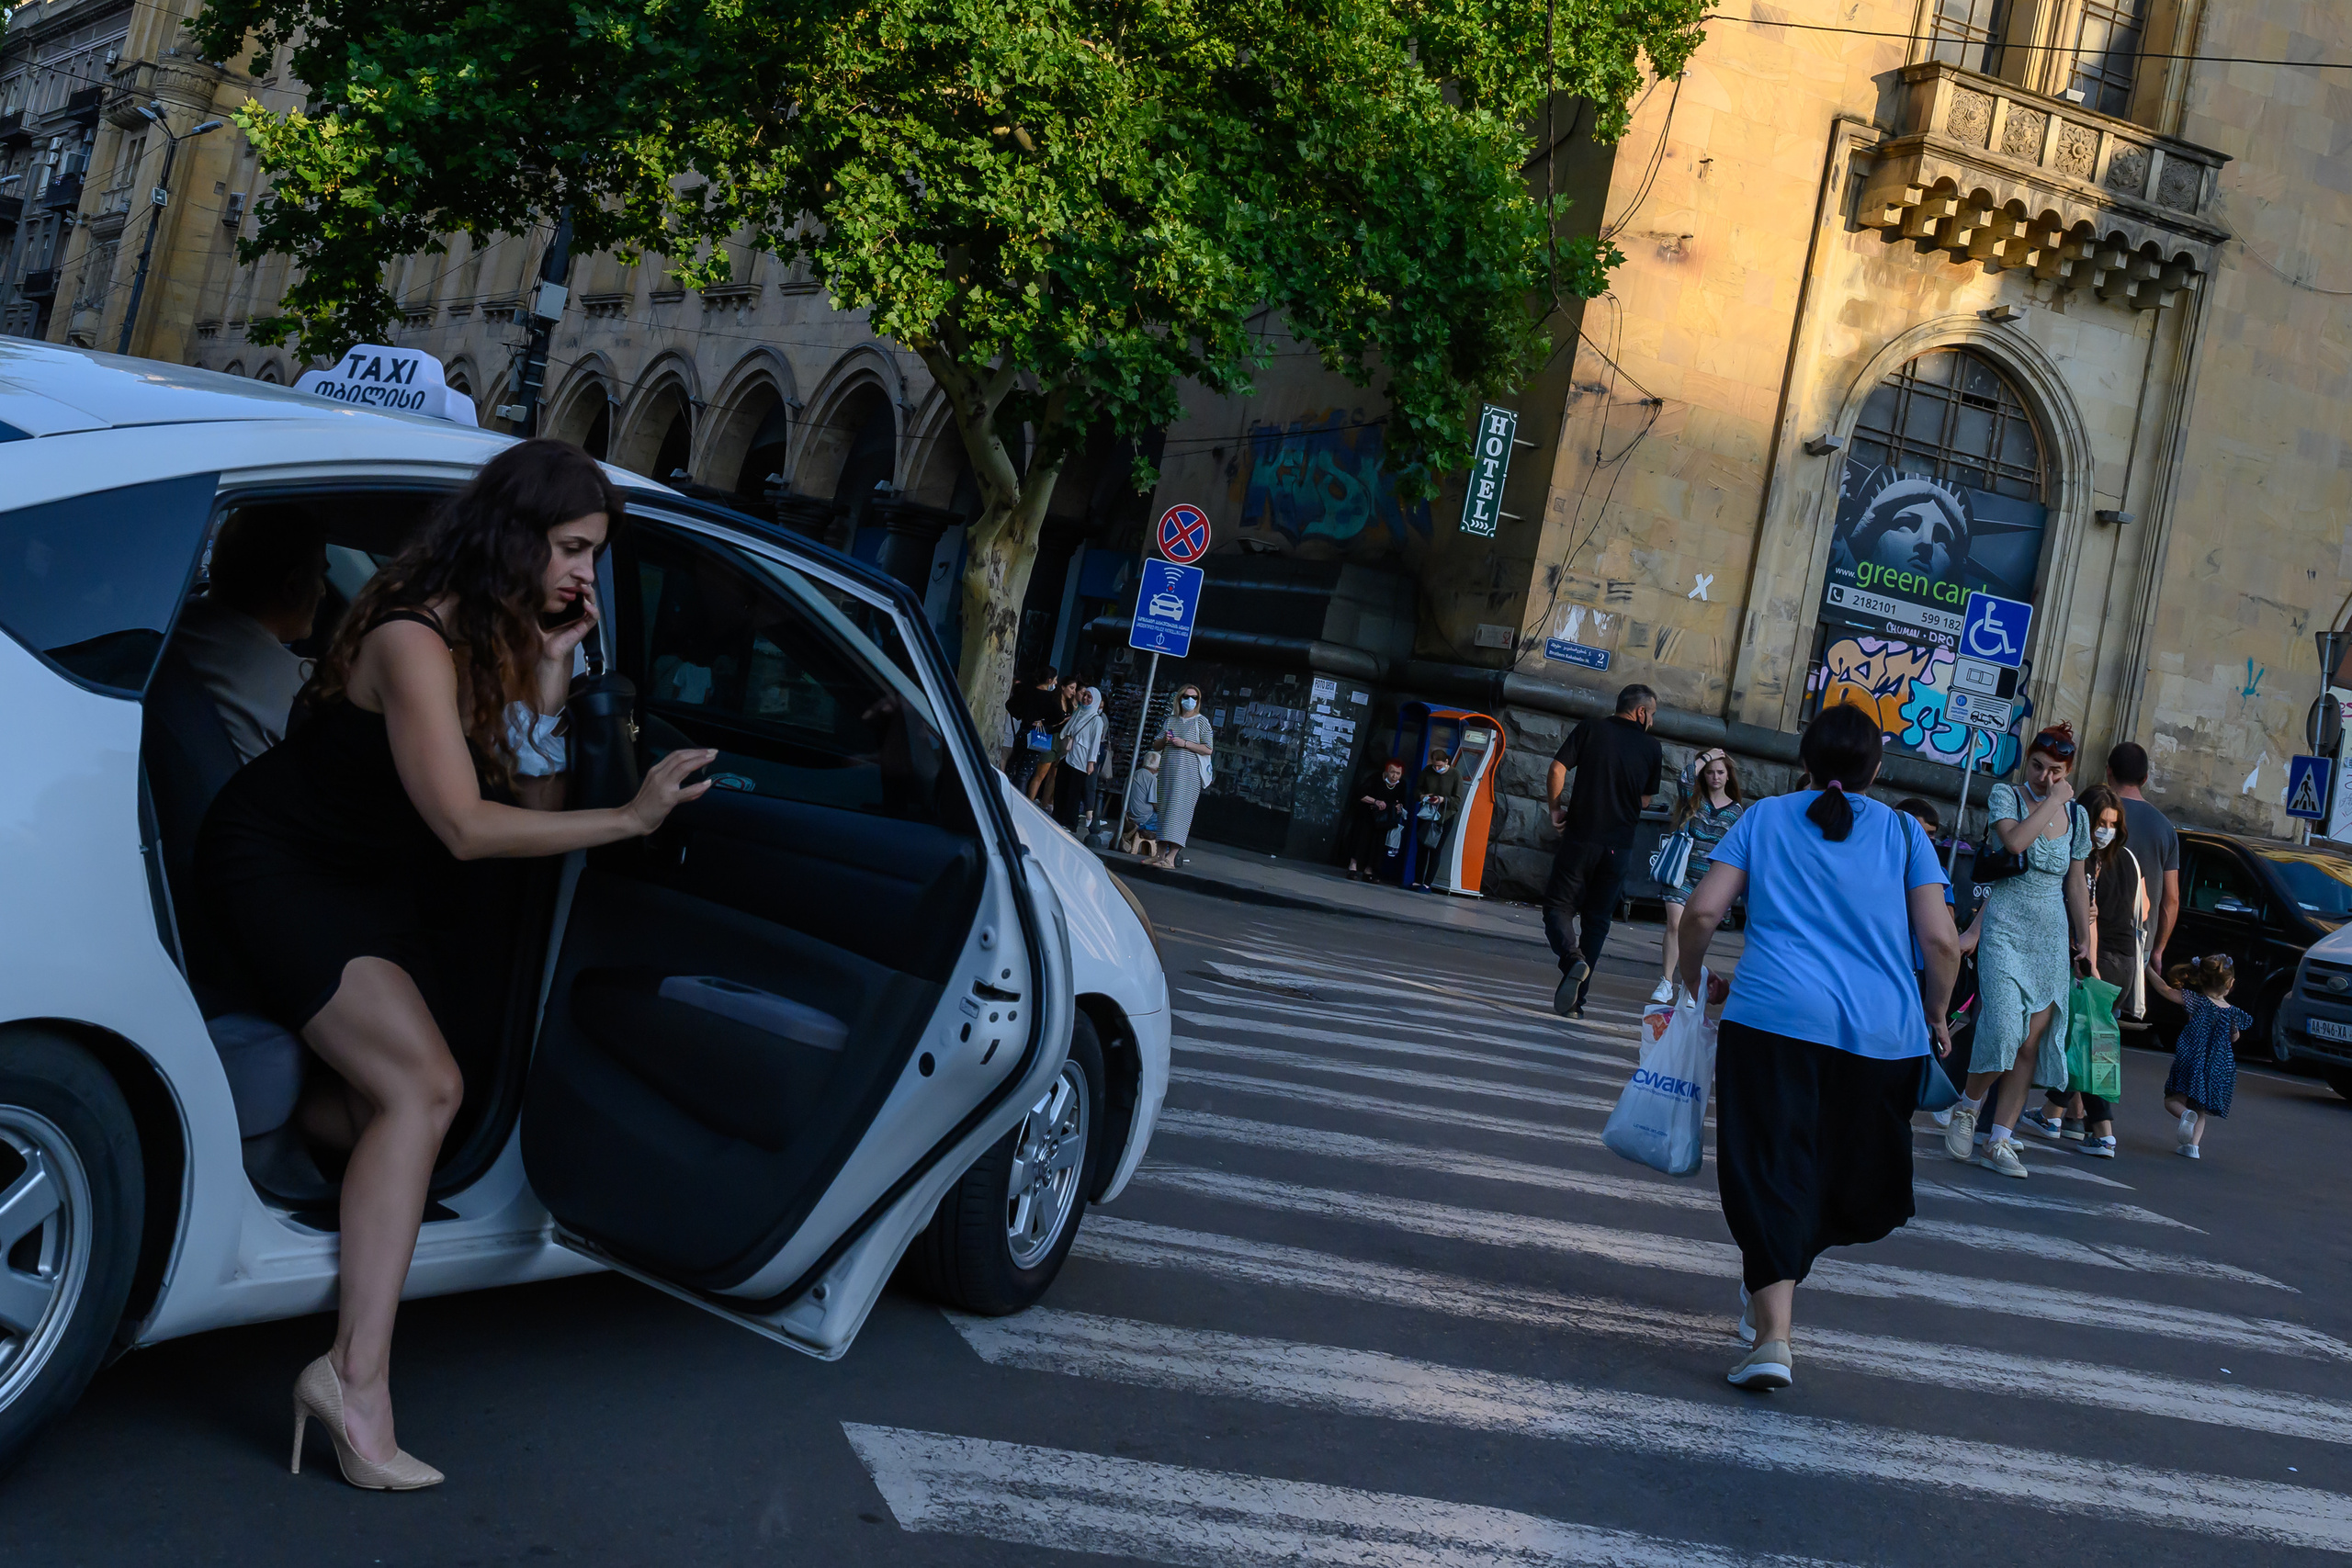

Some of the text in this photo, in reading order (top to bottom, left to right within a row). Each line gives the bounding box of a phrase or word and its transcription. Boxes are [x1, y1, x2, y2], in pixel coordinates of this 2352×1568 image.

[347, 354, 419, 385] TAXI
[314, 381, 425, 410] თბილისი
[1473, 414, 1509, 521] HOTEL
[1835, 561, 1986, 605] www. green car
[1852, 595, 1962, 631] 2182101 599 182
[1597, 653, 1604, 664] 2
